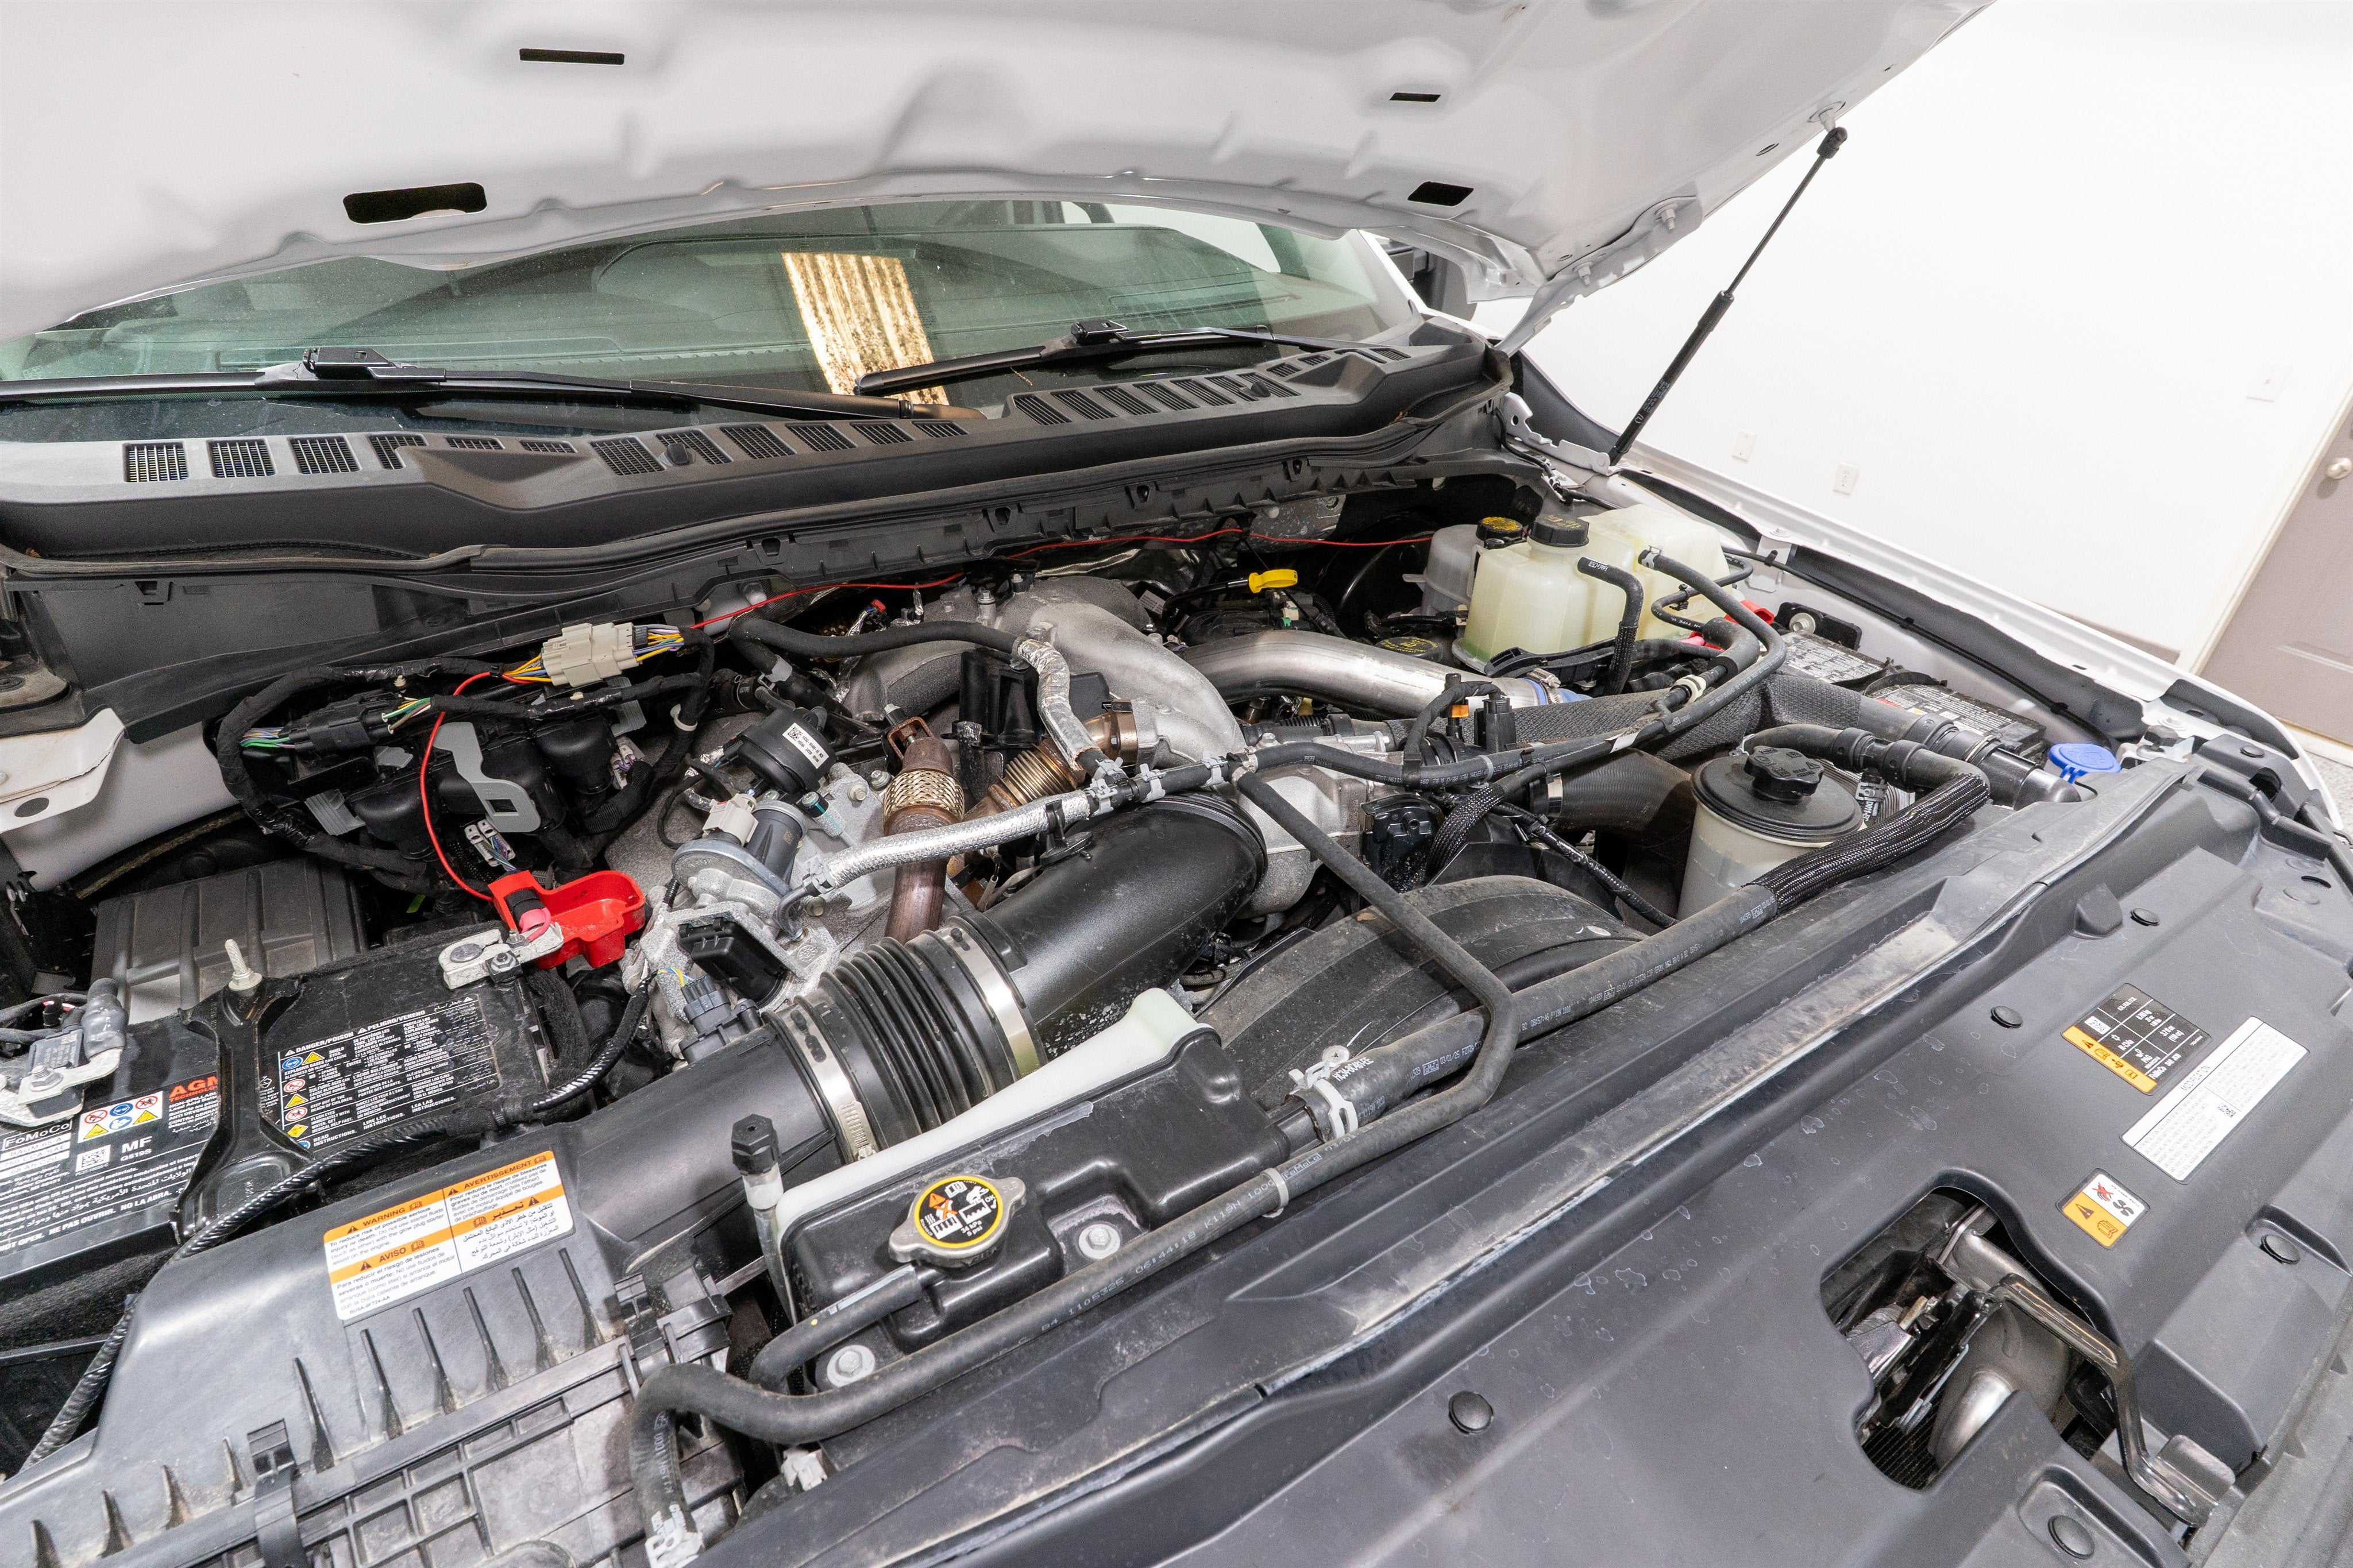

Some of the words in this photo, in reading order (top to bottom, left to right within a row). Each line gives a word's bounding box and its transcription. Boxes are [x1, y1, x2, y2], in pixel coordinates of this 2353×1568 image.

[367, 1010, 426, 1031] PELIGRO/VENENO
[295, 1032, 354, 1053] DANGER/POISON
[328, 1046, 345, 1055] SHIELD
[411, 1095, 456, 1114] INSTRUCCIONES.
[362, 1111, 406, 1130] INSTRUCTIONS.
[362, 1118, 376, 1126] LIRE
[6, 1121, 68, 1148] FoMoCo
[122, 1135, 152, 1153] MF
[313, 1133, 329, 1142] READ
[313, 1129, 357, 1147] INSTRUCTIONS.
[121, 1147, 152, 1162] G519S
[463, 1160, 533, 1189] AVERTISSEMENT
[1283, 1153, 1320, 1179] FoMoCo
[449, 1194, 464, 1202] Pour
[464, 1185, 485, 1196] réduire
[493, 1176, 511, 1186] risque
[520, 1163, 547, 1176] blessures
[450, 1196, 470, 1207] graves
[488, 1184, 504, 1192] mort,
[984, 1194, 996, 1203] OK
[18, 1232, 43, 1246] OPEN.
[48, 1225, 61, 1235] NE
[62, 1219, 79, 1230] PAS
[81, 1207, 115, 1224] OUVRIR.
[121, 1202, 132, 1211] NO
[134, 1198, 145, 1206] LA
[147, 1189, 171, 1202] ABRA.
[338, 1233, 360, 1244] reduce
[361, 1227, 373, 1235] risk
[381, 1215, 407, 1228] possible
[408, 1206, 431, 1218] serious
[362, 1207, 406, 1227] WARNING
[959, 1225, 970, 1234] 34
[969, 1219, 983, 1230] kPa
[330, 1243, 348, 1254] injury
[357, 1233, 376, 1243] death:
[410, 1213, 429, 1223] starter
[428, 1207, 443, 1216] fluids
[971, 1226, 983, 1234] psi
[378, 1246, 407, 1262] AVISO
[1067, 1276, 1125, 1316] 1105325
[1203, 1199, 1241, 1229] K119N
[336, 1280, 352, 1289] Para
[353, 1270, 375, 1283] reducir
[384, 1260, 404, 1272] riesgo
[414, 1246, 439, 1260] lesiones
[338, 1283, 363, 1296] severas
[370, 1271, 395, 1284] muerte:
[417, 1254, 436, 1265] fluidos
